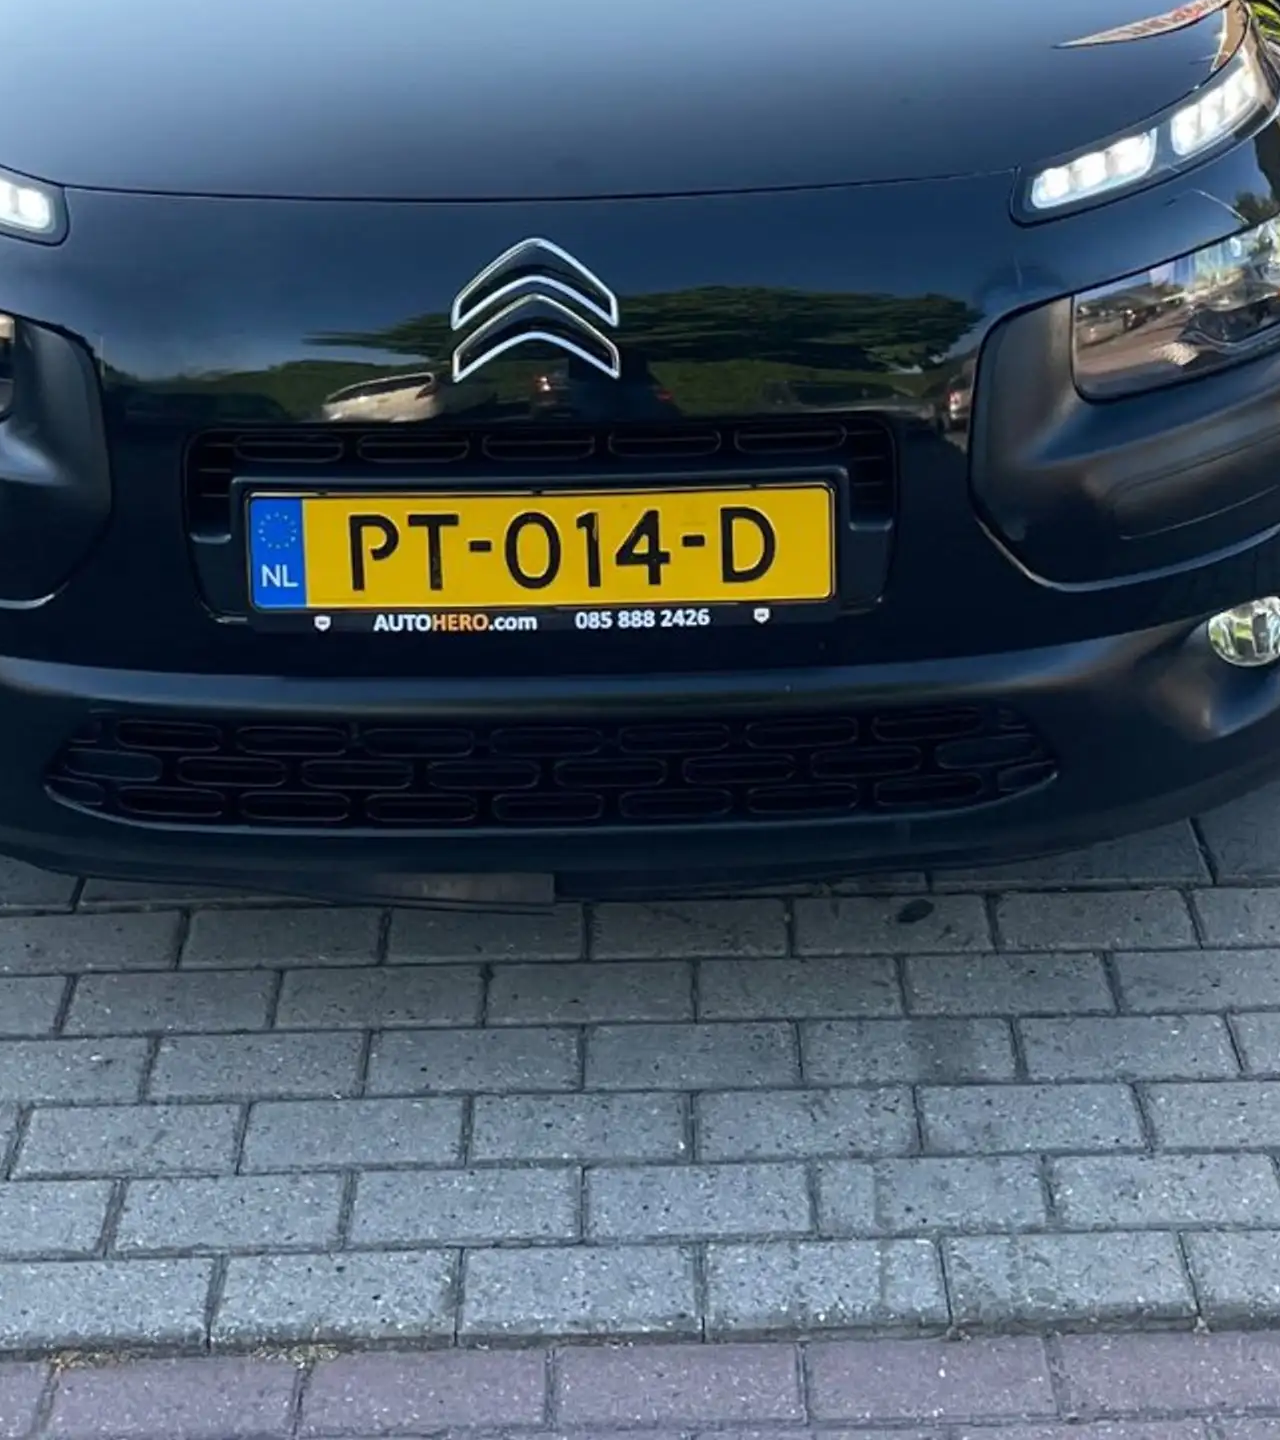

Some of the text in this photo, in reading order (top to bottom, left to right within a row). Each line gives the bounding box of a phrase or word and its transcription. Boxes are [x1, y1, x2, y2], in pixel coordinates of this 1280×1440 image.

[261, 507, 776, 591] NL PT-014-D
[373, 608, 711, 633] AUTOHERO.com 085 888 2426
